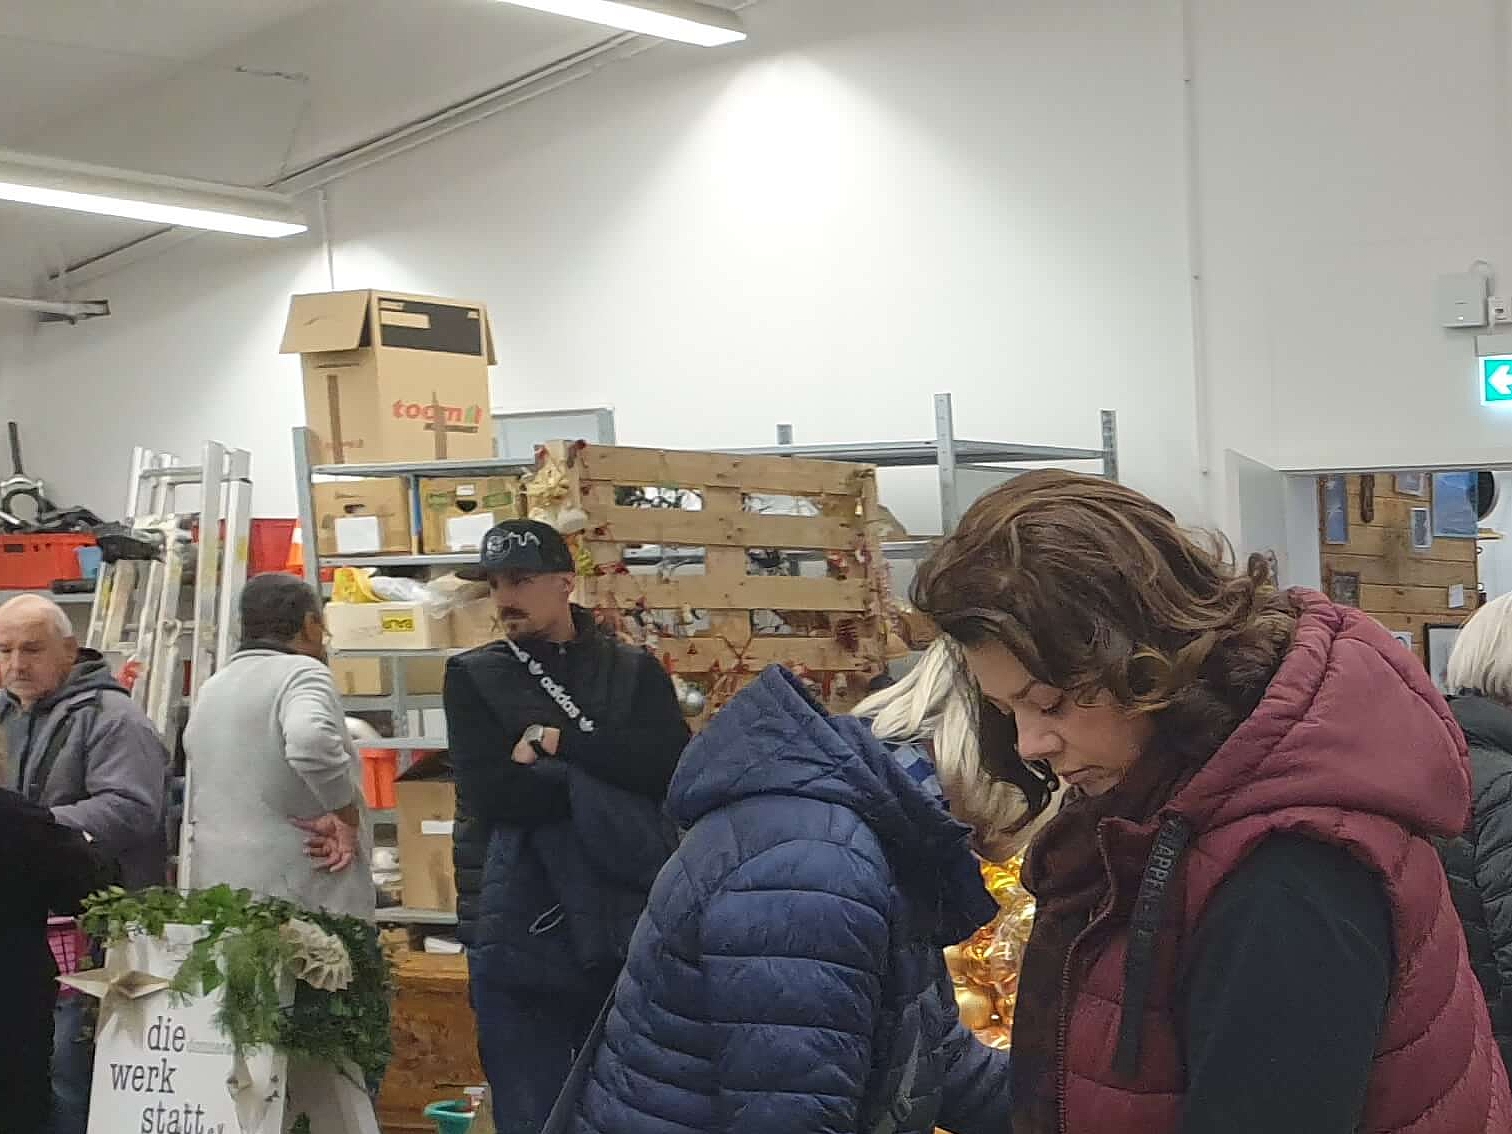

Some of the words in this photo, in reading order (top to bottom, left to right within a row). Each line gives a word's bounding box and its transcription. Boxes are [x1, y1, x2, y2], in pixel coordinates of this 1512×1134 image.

[539, 675, 582, 719] adidas
[146, 1014, 188, 1053] die
[109, 1057, 178, 1095] werk
